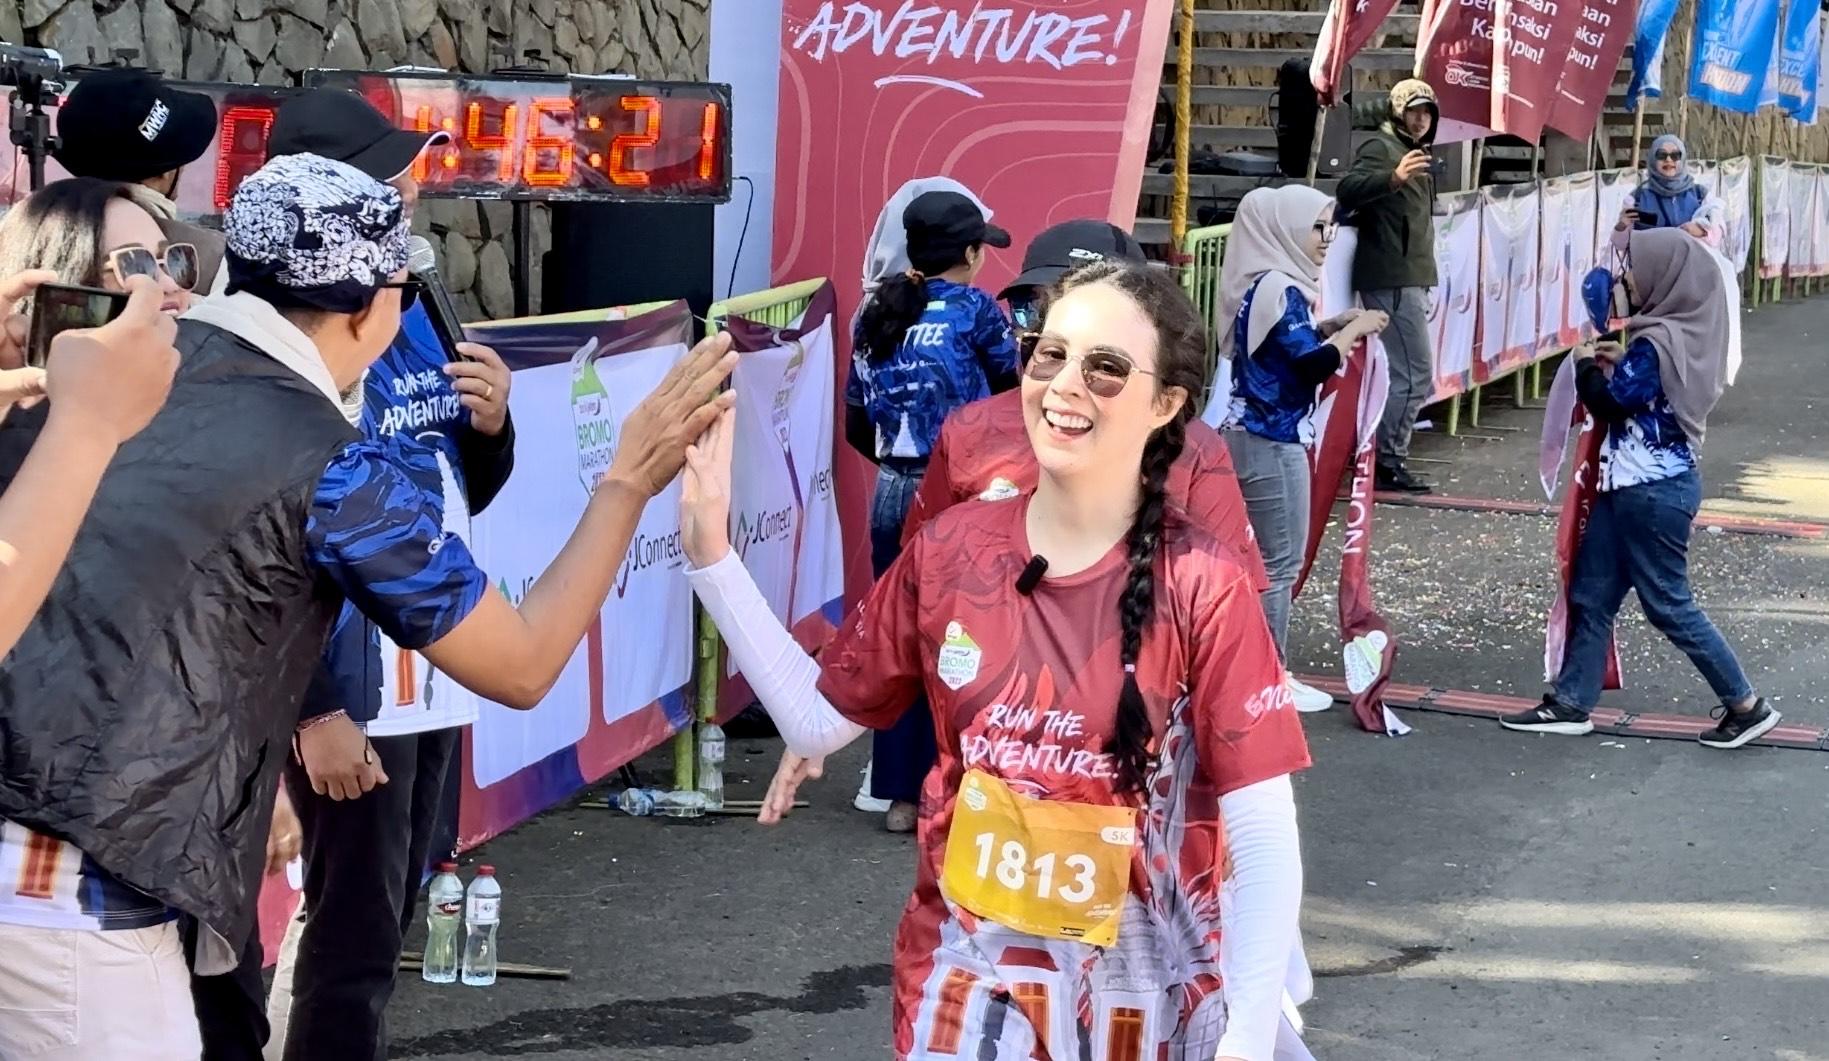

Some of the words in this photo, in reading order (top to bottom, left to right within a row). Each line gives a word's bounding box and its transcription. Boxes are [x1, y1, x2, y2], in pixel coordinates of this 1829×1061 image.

[793, 0, 1133, 70] ADVENTURE!
[393, 370, 416, 396] RUN
[416, 368, 442, 393] THE
[577, 418, 612, 450] BROMO
[580, 447, 614, 470] MARATHON
[752, 505, 792, 545] JConnect
[633, 527, 682, 571] JConnect
[940, 656, 976, 669] BROMO
[986, 703, 1037, 731] RUN
[1043, 709, 1086, 740] THE
[1111, 830, 1129, 842] 5K
[975, 832, 1097, 904] 1813
